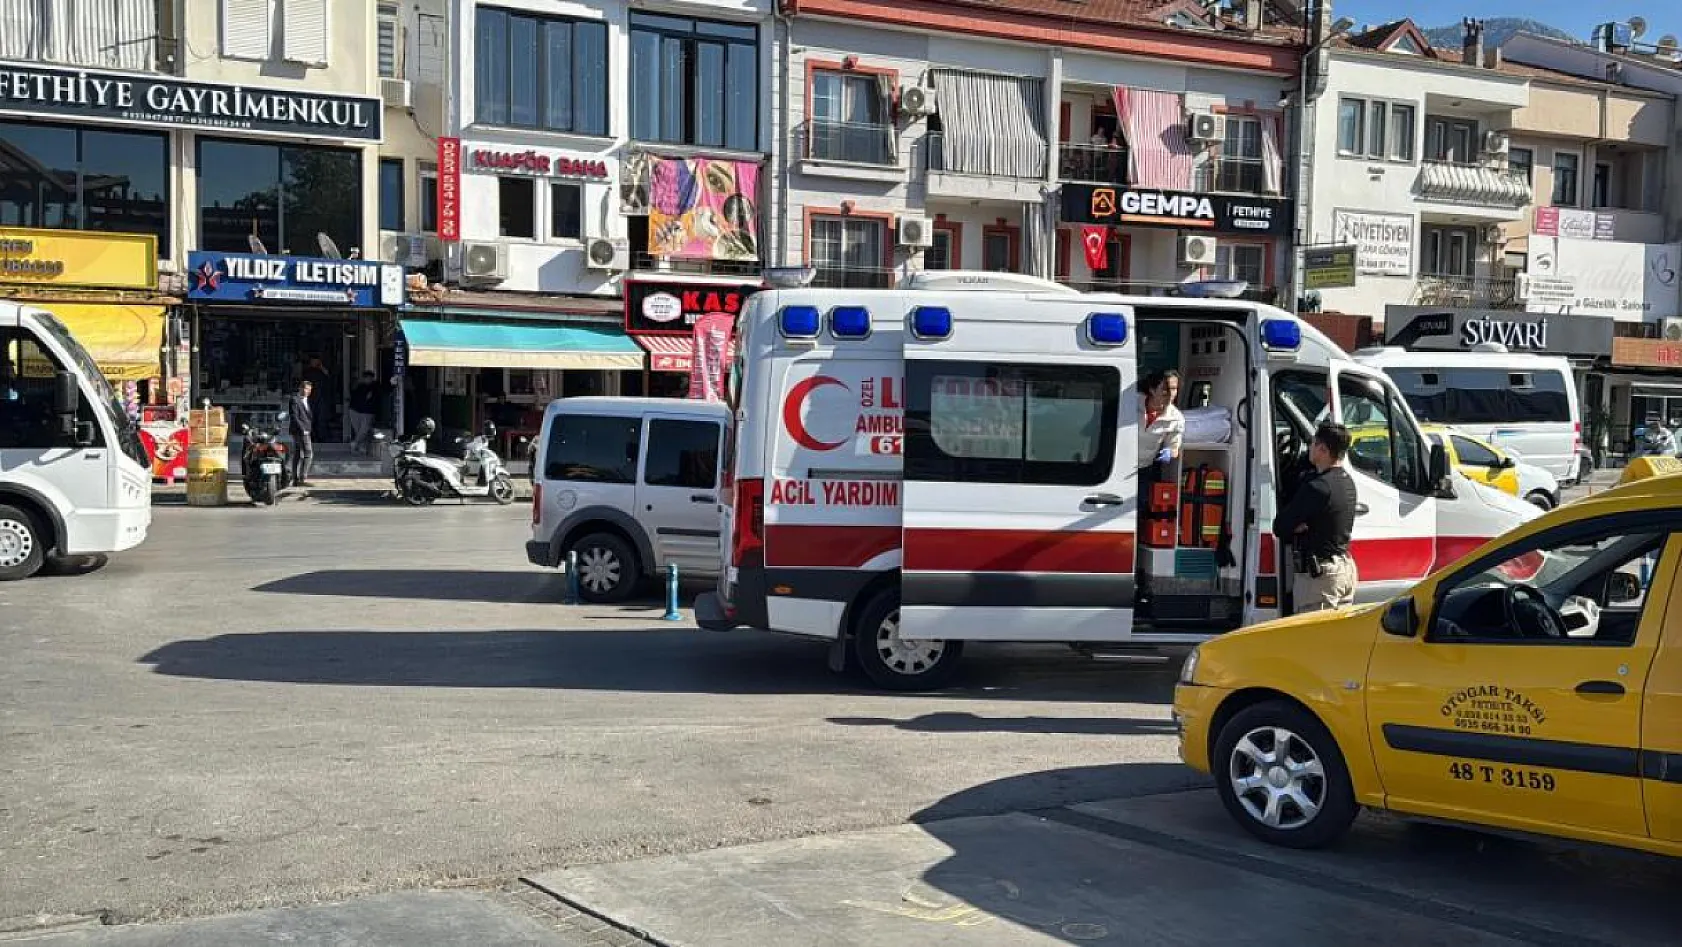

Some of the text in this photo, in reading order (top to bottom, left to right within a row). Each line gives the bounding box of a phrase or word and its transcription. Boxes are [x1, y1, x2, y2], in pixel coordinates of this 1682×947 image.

[0, 72, 133, 107] FETHİYE
[147, 84, 368, 128] GAYRİMENKUL
[474, 149, 607, 178] KUAFÖR BAHA
[1121, 191, 1214, 218] GEMPA
[224, 257, 286, 281] YILDIZ
[296, 260, 377, 285] İLETİŞİM
[1465, 315, 1548, 349] SÜVARİ
[822, 481, 897, 506] YARDIM
[1441, 685, 1499, 716] OTOGAR
[1450, 762, 1555, 791] 48 T 3159
